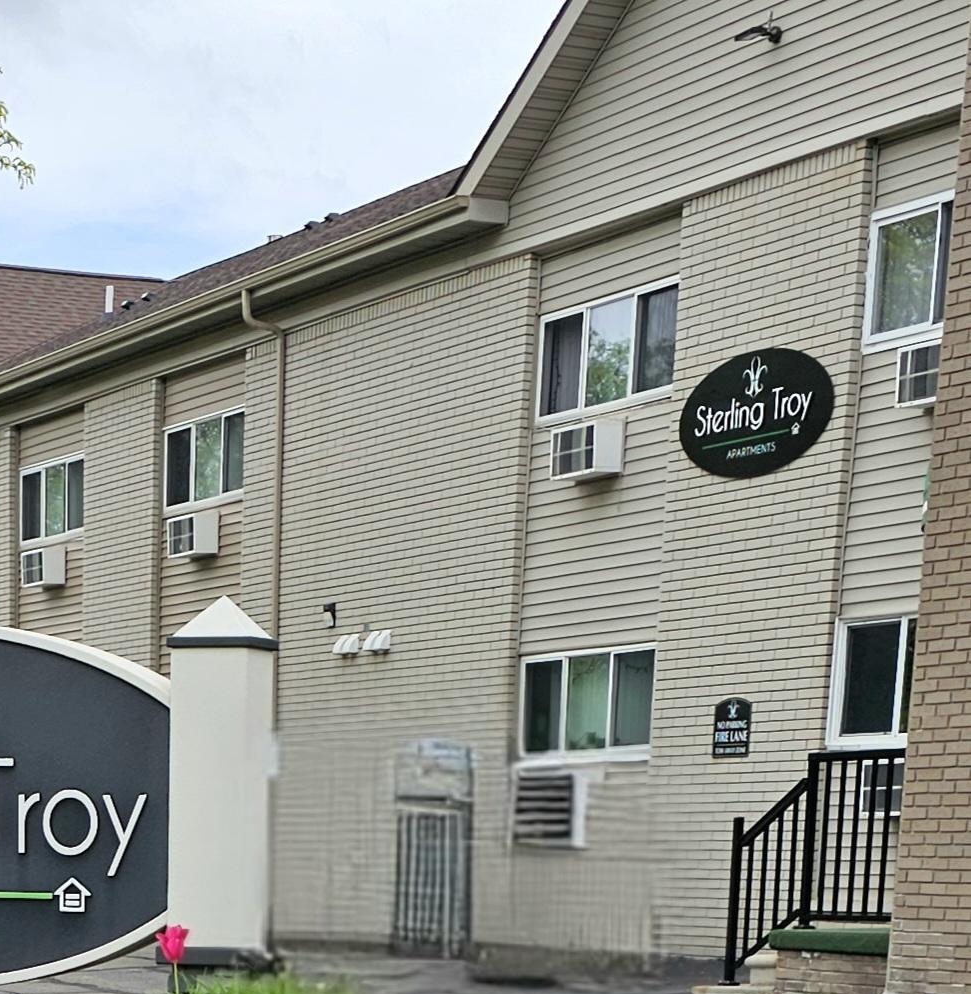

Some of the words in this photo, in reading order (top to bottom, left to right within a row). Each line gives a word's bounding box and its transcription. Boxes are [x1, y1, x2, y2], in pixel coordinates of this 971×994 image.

[694, 398, 765, 437] Sterling
[771, 386, 813, 421] Troy
[726, 442, 776, 459] APARTMENTS
[715, 731, 729, 742] FIRE
[730, 730, 748, 742] LANE
